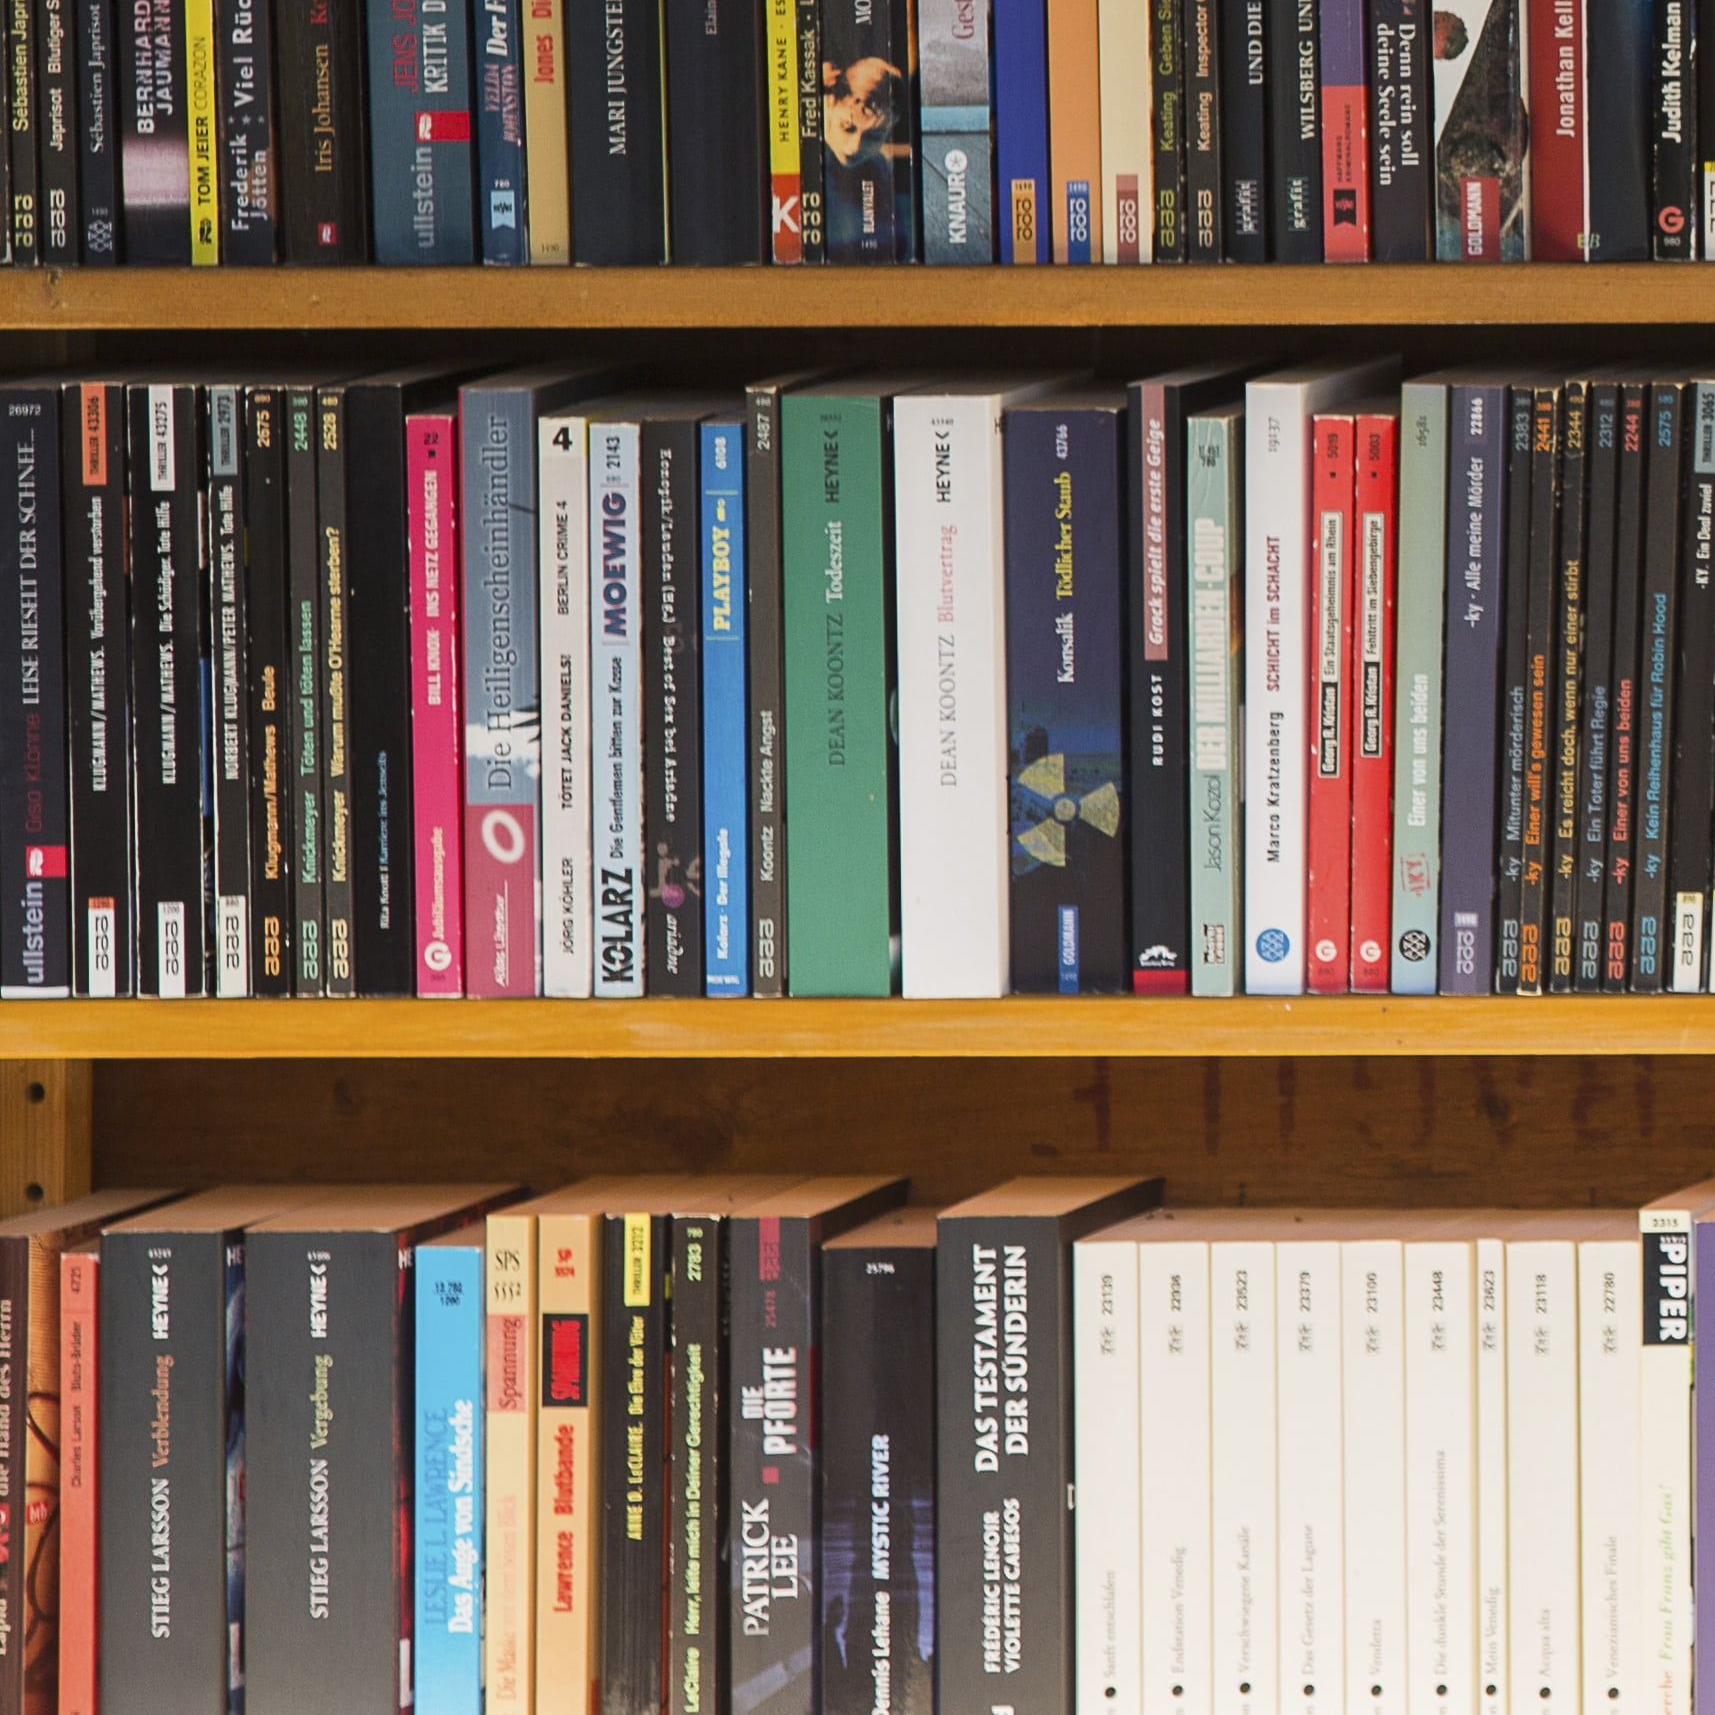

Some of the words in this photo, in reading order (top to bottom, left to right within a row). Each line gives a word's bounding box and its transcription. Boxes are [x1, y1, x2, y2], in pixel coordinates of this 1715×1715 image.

[416, 146, 434, 248] ullstein
[948, 173, 966, 244] KNAUR
[551, 428, 572, 452] 4
[601, 493, 628, 636] MOEWIG
[712, 526, 730, 630] PLAYBOY
[938, 524, 957, 624] Blutvertrag
[941, 634, 956, 722] KOONTZ
[1056, 612, 1074, 683] Konsalik
[941, 731, 958, 787] DEAN
[25, 882, 43, 984] ullstein
[600, 867, 635, 983] KOLARZ
[975, 1245, 998, 1408] TESTAMENT
[1659, 1245, 1686, 1340] PIPER
[744, 1387, 763, 1419] DIE
[763, 1347, 797, 1455] PFORTE
[974, 1420, 998, 1474] DAS
[1005, 1399, 1028, 1456] DER
[151, 1478, 169, 1570] LARSSON
[151, 1575, 171, 1639] STIEG
